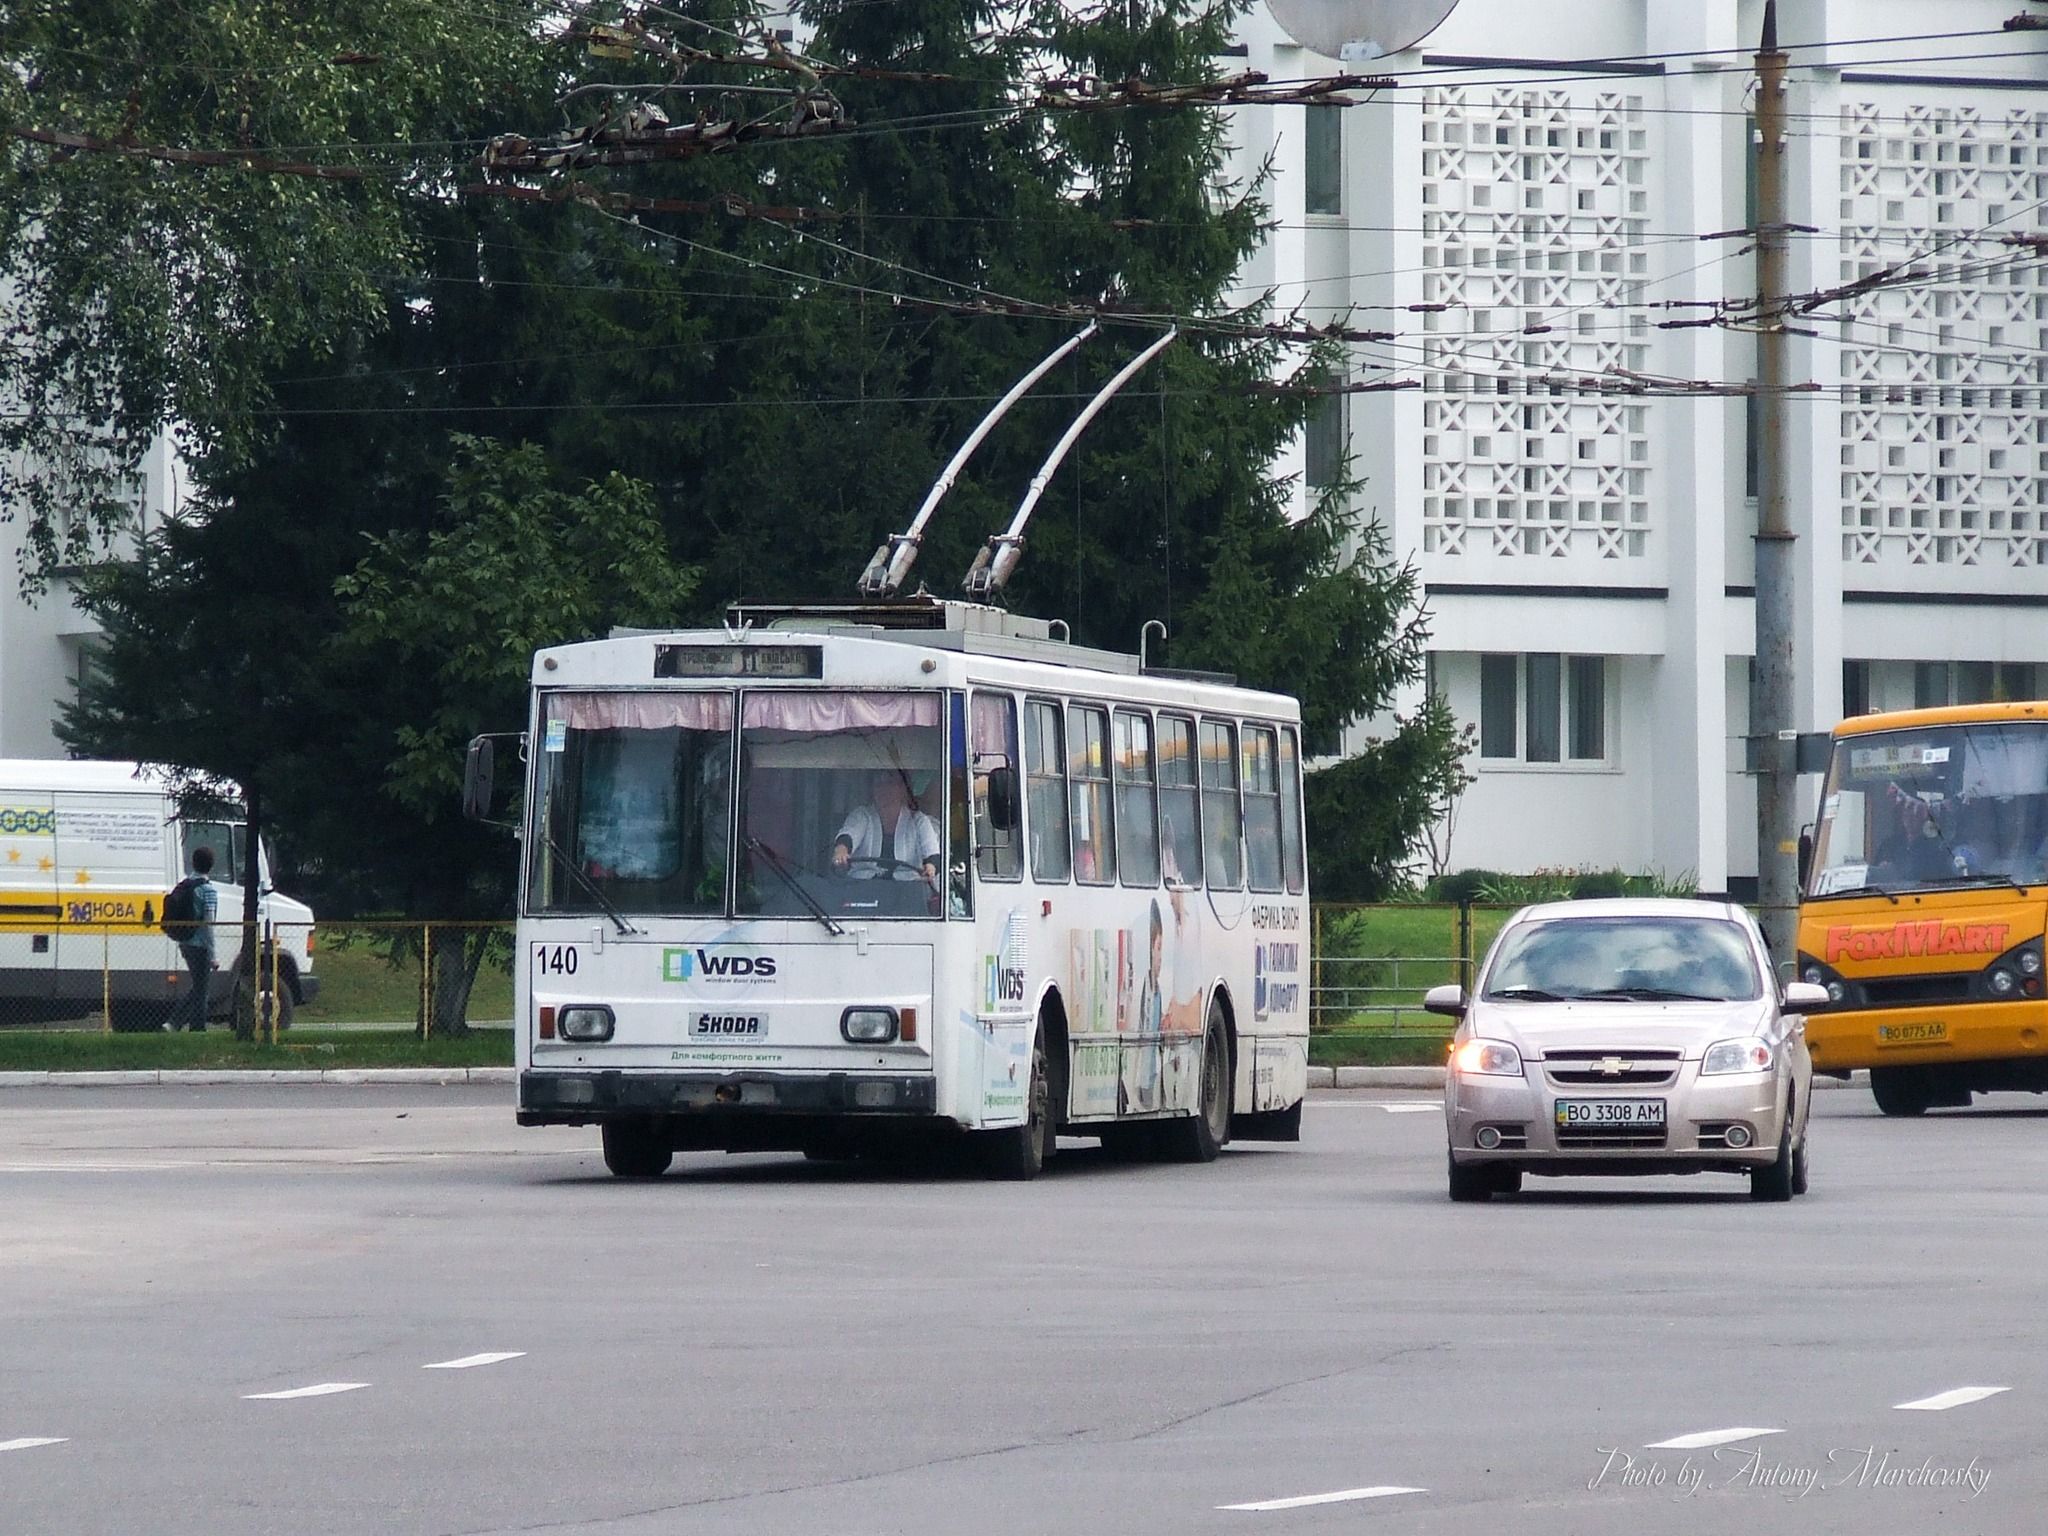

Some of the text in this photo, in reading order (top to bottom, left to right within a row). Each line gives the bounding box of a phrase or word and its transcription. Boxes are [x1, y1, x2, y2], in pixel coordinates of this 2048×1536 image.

[537, 945, 578, 975] 140
[696, 949, 776, 976] WDS
[996, 954, 1024, 1001] WDS
[697, 1013, 759, 1033] ŠKODA
[671, 1050, 783, 1063] Для комфортного життя
[1595, 1105, 1632, 1121] 3308
